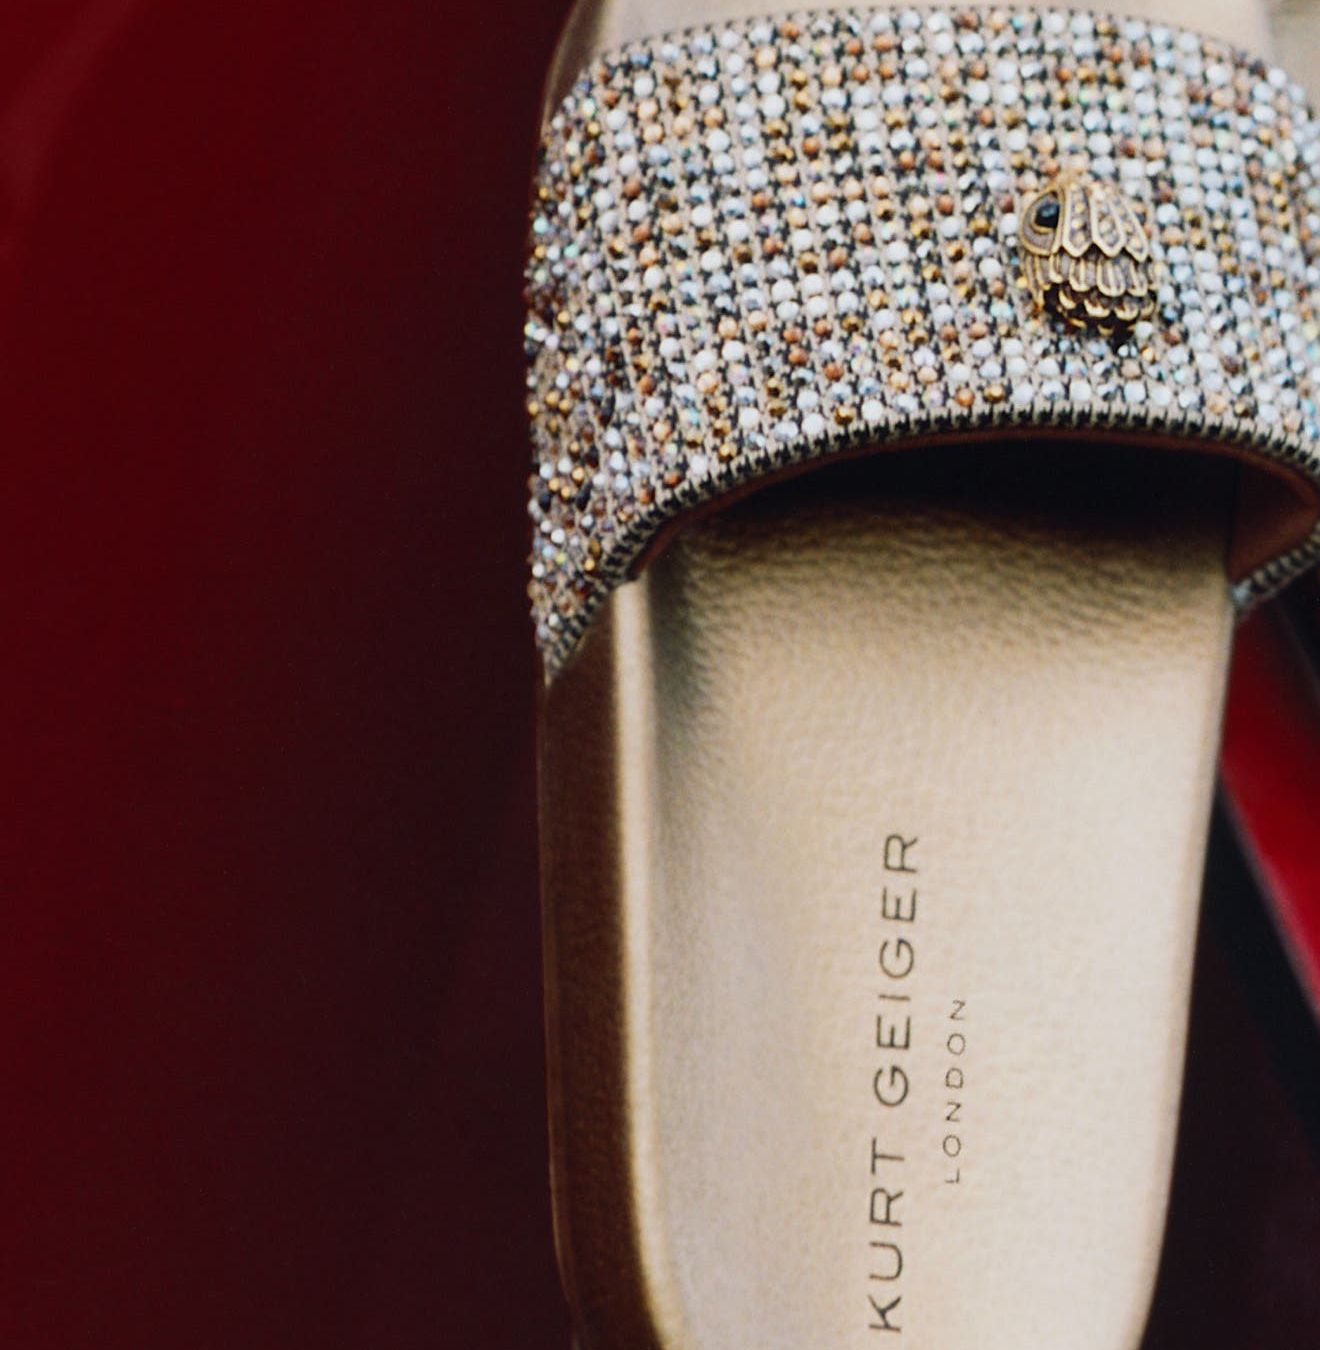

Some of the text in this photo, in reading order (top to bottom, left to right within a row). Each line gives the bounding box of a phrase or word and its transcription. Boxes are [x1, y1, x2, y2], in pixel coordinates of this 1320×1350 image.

[868, 833, 919, 1333] KURT GEIGER
[942, 1000, 966, 1185] LONDON
